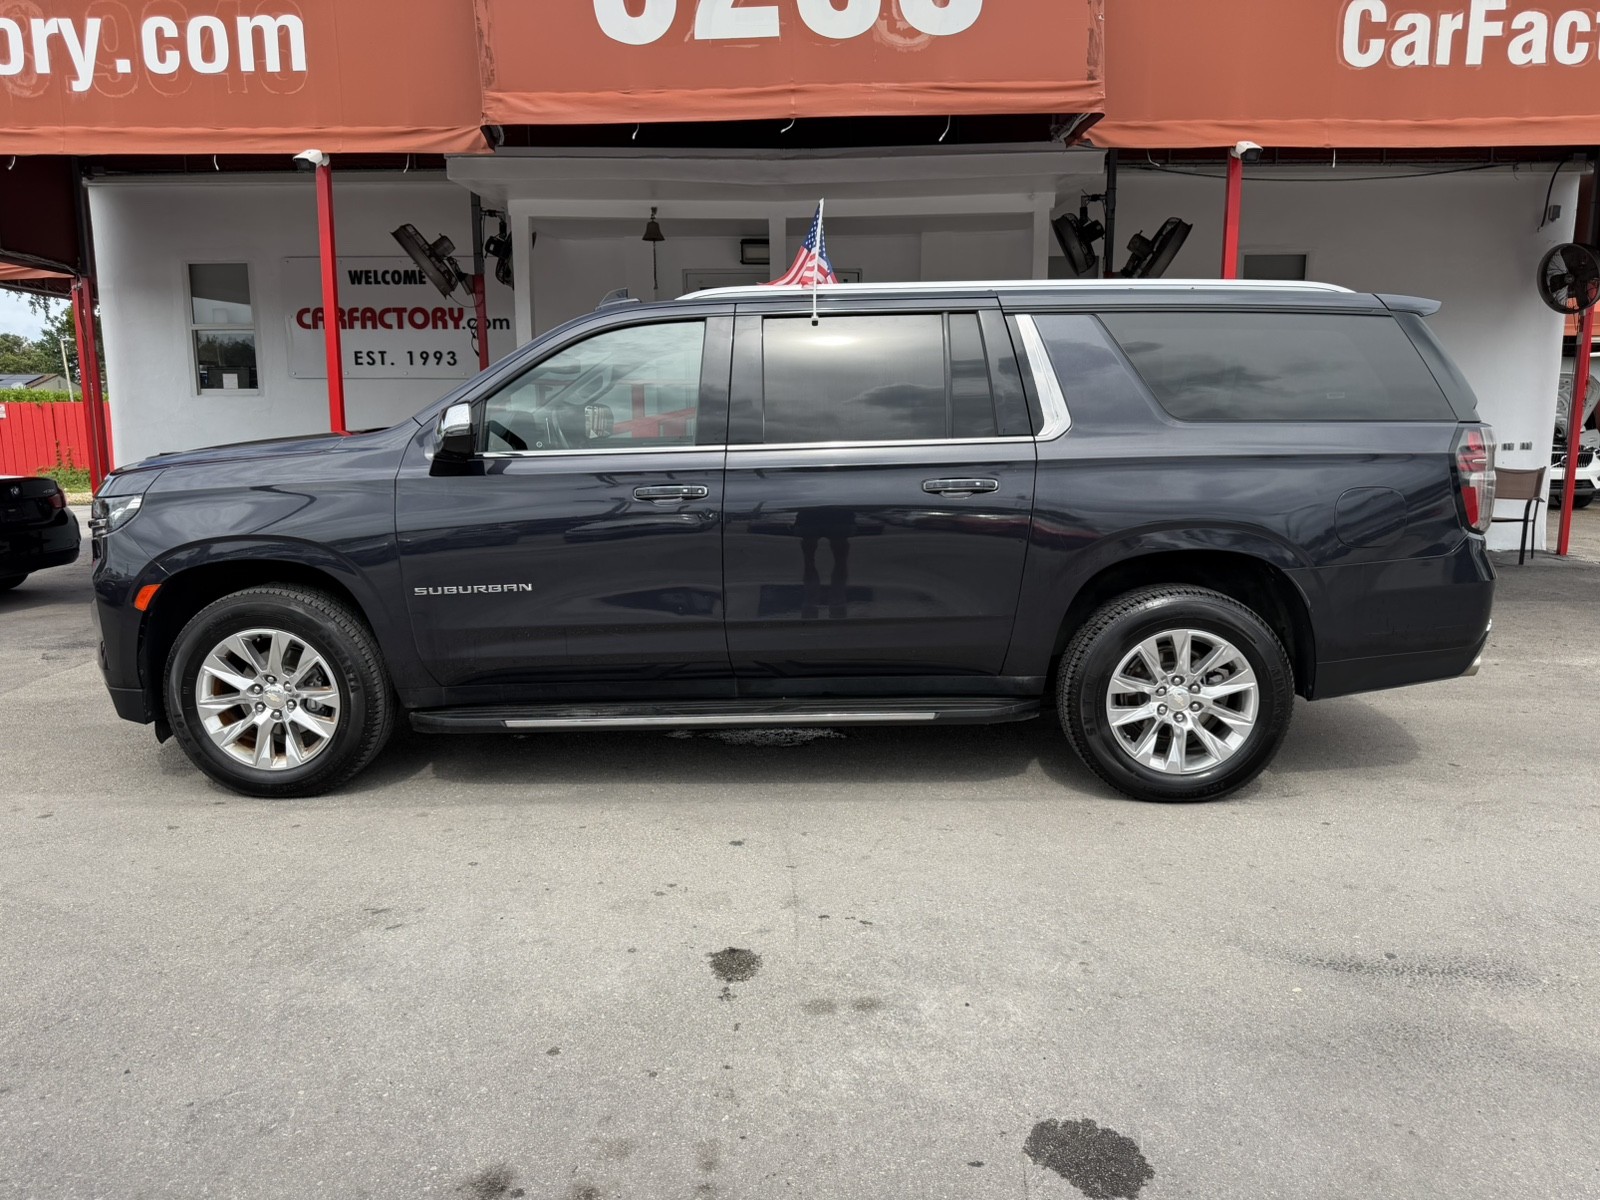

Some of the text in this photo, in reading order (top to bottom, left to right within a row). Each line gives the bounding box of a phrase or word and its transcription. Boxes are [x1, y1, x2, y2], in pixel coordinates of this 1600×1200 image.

[1343, 0, 1600, 67] CarFac
[348, 269, 427, 285] WELCOME
[354, 351, 457, 366] EST. 1993
[414, 583, 533, 596] SUBURBAN
